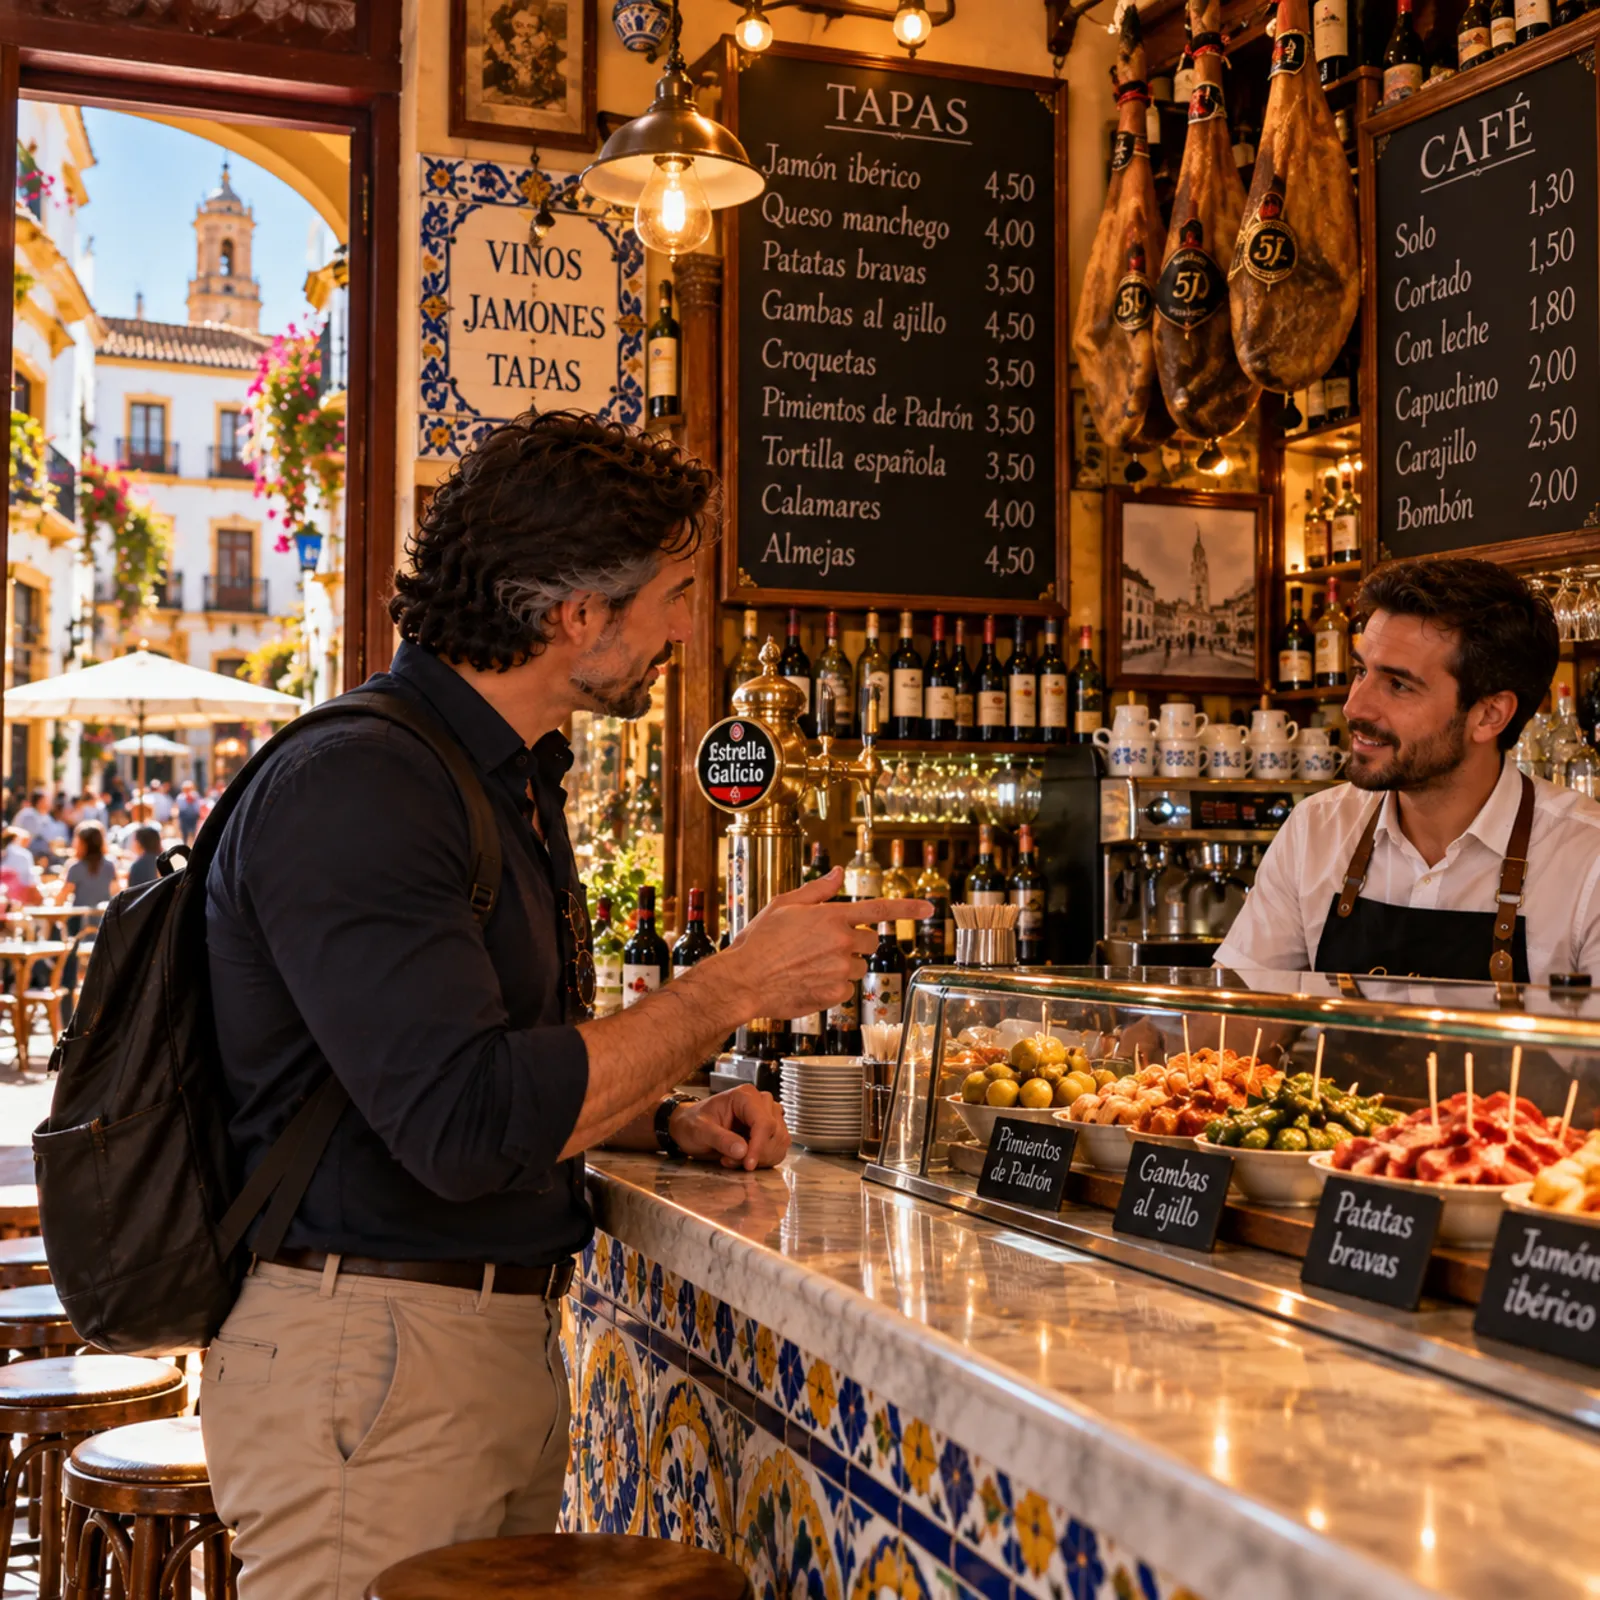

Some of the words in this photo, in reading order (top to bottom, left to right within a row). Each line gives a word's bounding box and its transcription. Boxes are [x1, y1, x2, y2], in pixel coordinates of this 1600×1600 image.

[826, 82, 969, 135] TAPAS
[1420, 91, 1533, 179] CAFÉ
[761, 142, 837, 180] Jamón
[847, 151, 921, 190] ibérico
[984, 170, 1035, 203] 4,50
[761, 191, 833, 229] Queso
[842, 204, 950, 249] manchego
[984, 217, 1035, 250] 4,00
[1395, 214, 1437, 259] Solo
[1528, 167, 1575, 217] 1,30
[486, 239, 582, 281] VINOS
[762, 240, 846, 278] Patatas
[856, 247, 927, 285] bravas
[985, 263, 1035, 296] 3,50
[1394, 258, 1472, 313] Cortado
[1529, 226, 1575, 275] 1,50
[463, 293, 605, 340] JAMONES
[761, 288, 853, 327] Gambas
[862, 297, 884, 329] al
[892, 301, 947, 342] ajillo
[984, 310, 1035, 343] 4,50
[1395, 331, 1434, 366] Con
[1441, 310, 1489, 355] leche
[1529, 286, 1576, 333] 1,80
[486, 353, 582, 393] TAPAS
[761, 337, 877, 383] Croquetas
[985, 356, 1035, 391] 3,50
[1395, 371, 1499, 428] Capuchino
[1527, 345, 1577, 392] 2,00
[762, 386, 866, 424] Pimientos
[872, 393, 897, 426] de
[904, 395, 974, 431] Padrón
[985, 403, 1035, 437] 3,50
[761, 435, 844, 470] Tortilla
[854, 444, 947, 484] española
[985, 451, 1035, 484] 3,50
[1395, 427, 1477, 480] Carajillo
[1527, 405, 1577, 451] 2,50
[761, 483, 881, 520] Calamares
[984, 498, 1035, 531] 4,00
[1396, 487, 1474, 531] Bombón
[1527, 465, 1578, 510] 2,00
[760, 531, 856, 577] Almejas
[984, 545, 1035, 577] 4,50
[708, 741, 766, 761] Estrella
[997, 1126, 1062, 1162] Pimientos
[990, 1157, 1006, 1183] de
[1007, 1160, 1053, 1193] Padrón
[1139, 1153, 1210, 1193] Gambas
[1132, 1187, 1154, 1217] al
[1154, 1195, 1199, 1232] ajillo
[1333, 1190, 1415, 1239] Patatas
[1327, 1231, 1400, 1279] bravas
[1511, 1228, 1600, 1284] Jamón
[1503, 1272, 1597, 1332] ibérico
